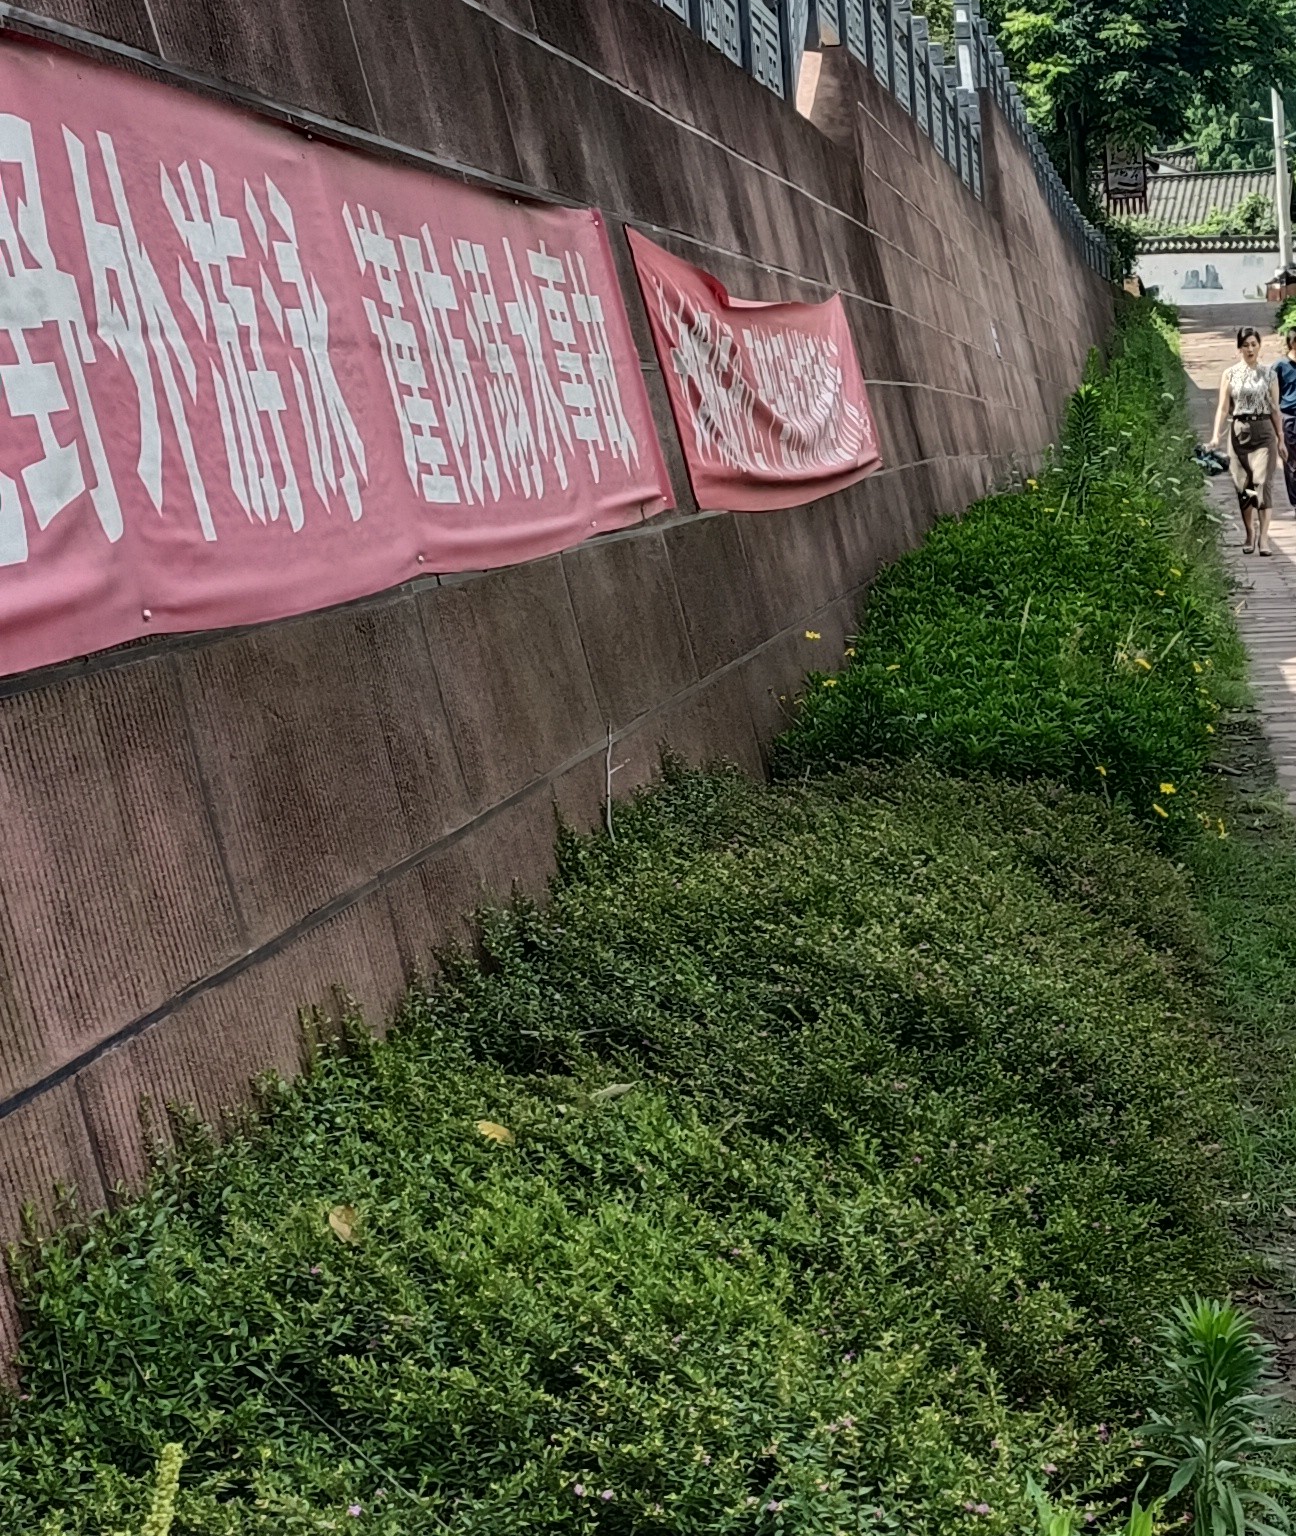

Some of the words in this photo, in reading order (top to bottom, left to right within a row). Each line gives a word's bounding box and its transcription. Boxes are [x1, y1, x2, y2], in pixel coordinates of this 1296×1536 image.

[0, 113, 369, 563] 野外游泳
[342, 200, 641, 508] 谨防溺水事故
